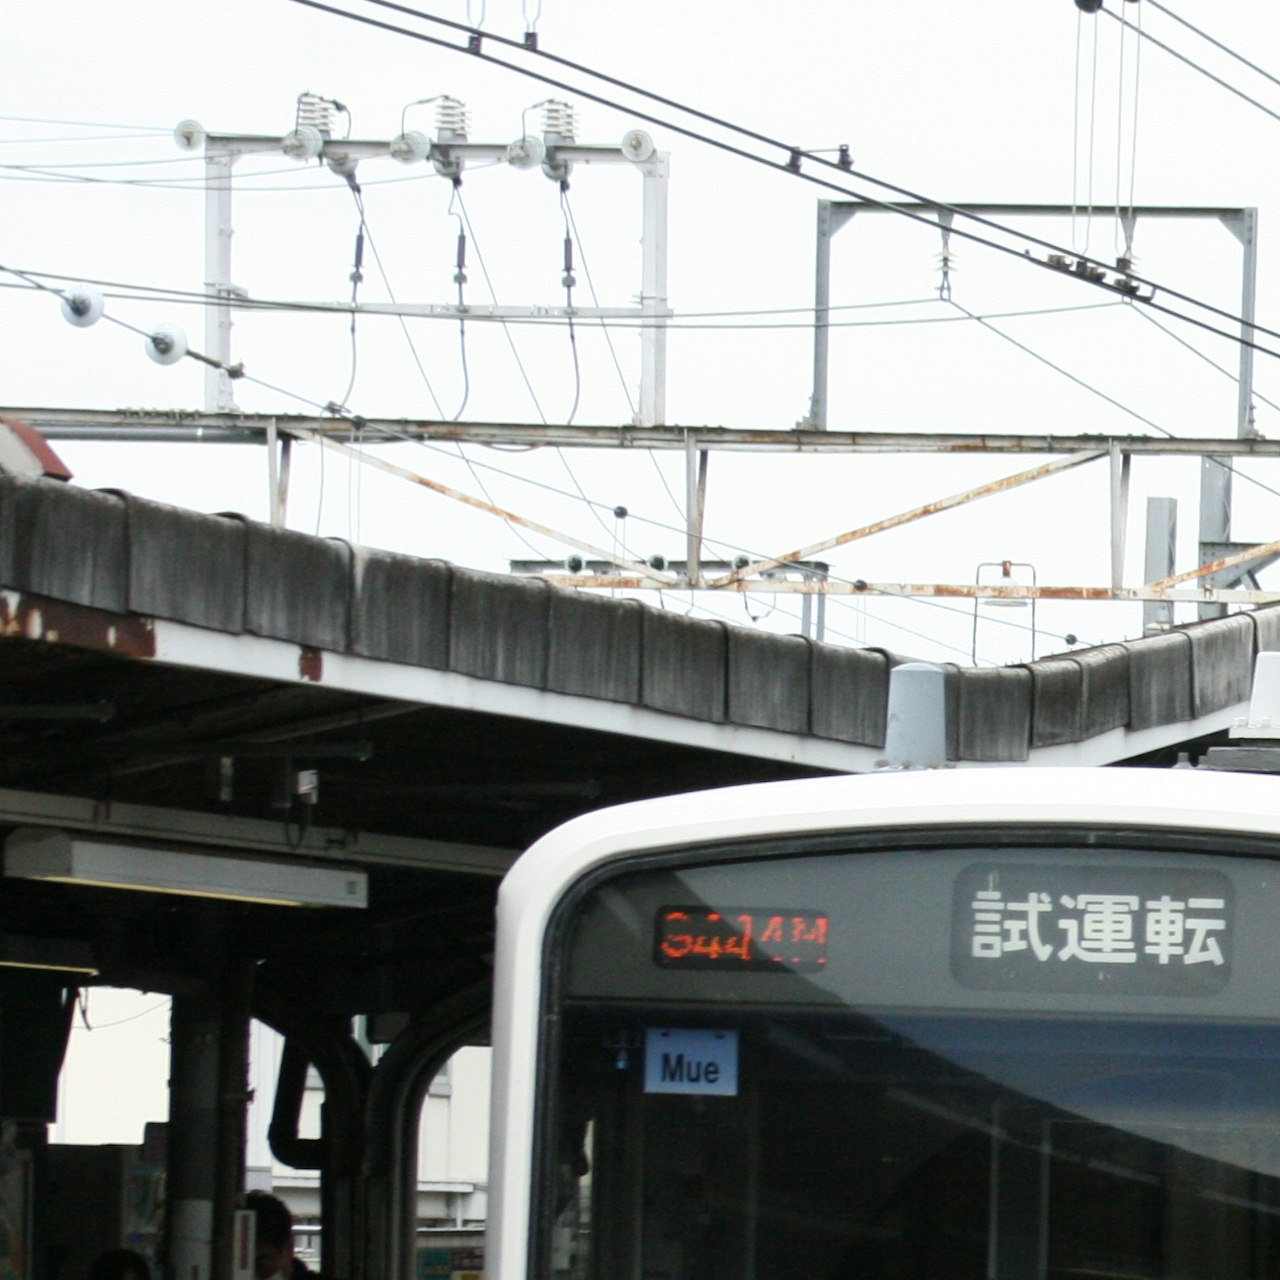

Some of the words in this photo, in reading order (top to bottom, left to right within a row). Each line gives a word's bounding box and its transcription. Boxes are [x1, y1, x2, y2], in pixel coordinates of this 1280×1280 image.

[971, 890, 1227, 966] 試運転
[661, 1053, 720, 1084] Mue
